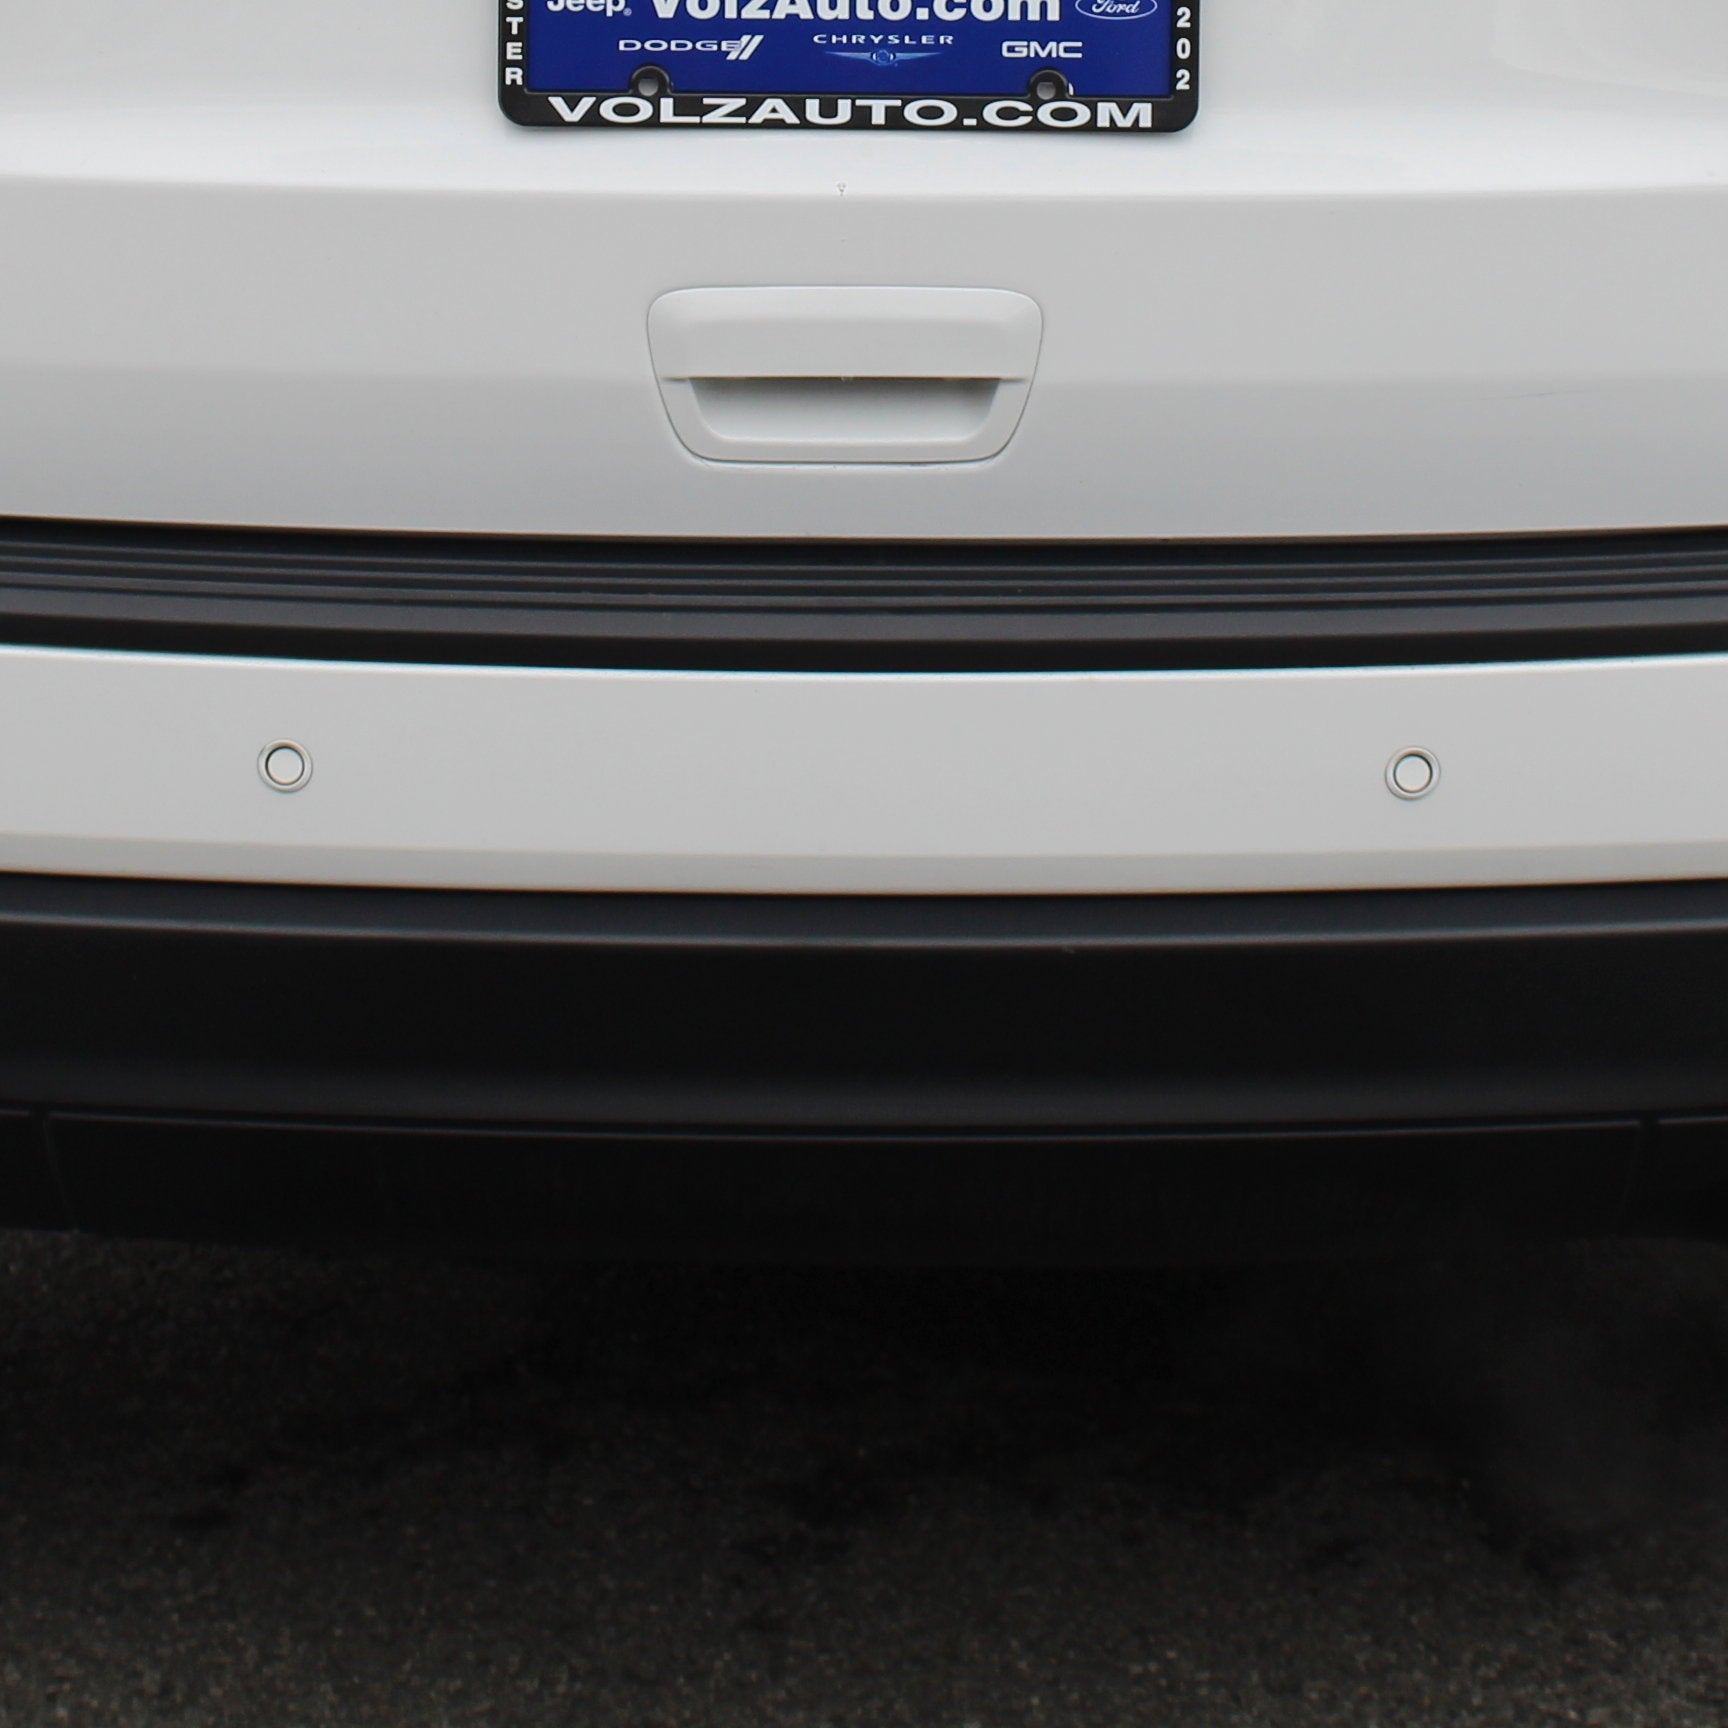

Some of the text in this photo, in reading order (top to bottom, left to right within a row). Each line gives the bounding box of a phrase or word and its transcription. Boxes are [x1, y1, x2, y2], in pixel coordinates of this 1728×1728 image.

[618, 39, 741, 52] DODGE
[812, 34, 955, 46] CHRYSLER
[1001, 40, 1084, 59] GMC
[1175, 6, 1192, 91] 202
[547, 96, 1153, 129] VOLZAUTO.COM
